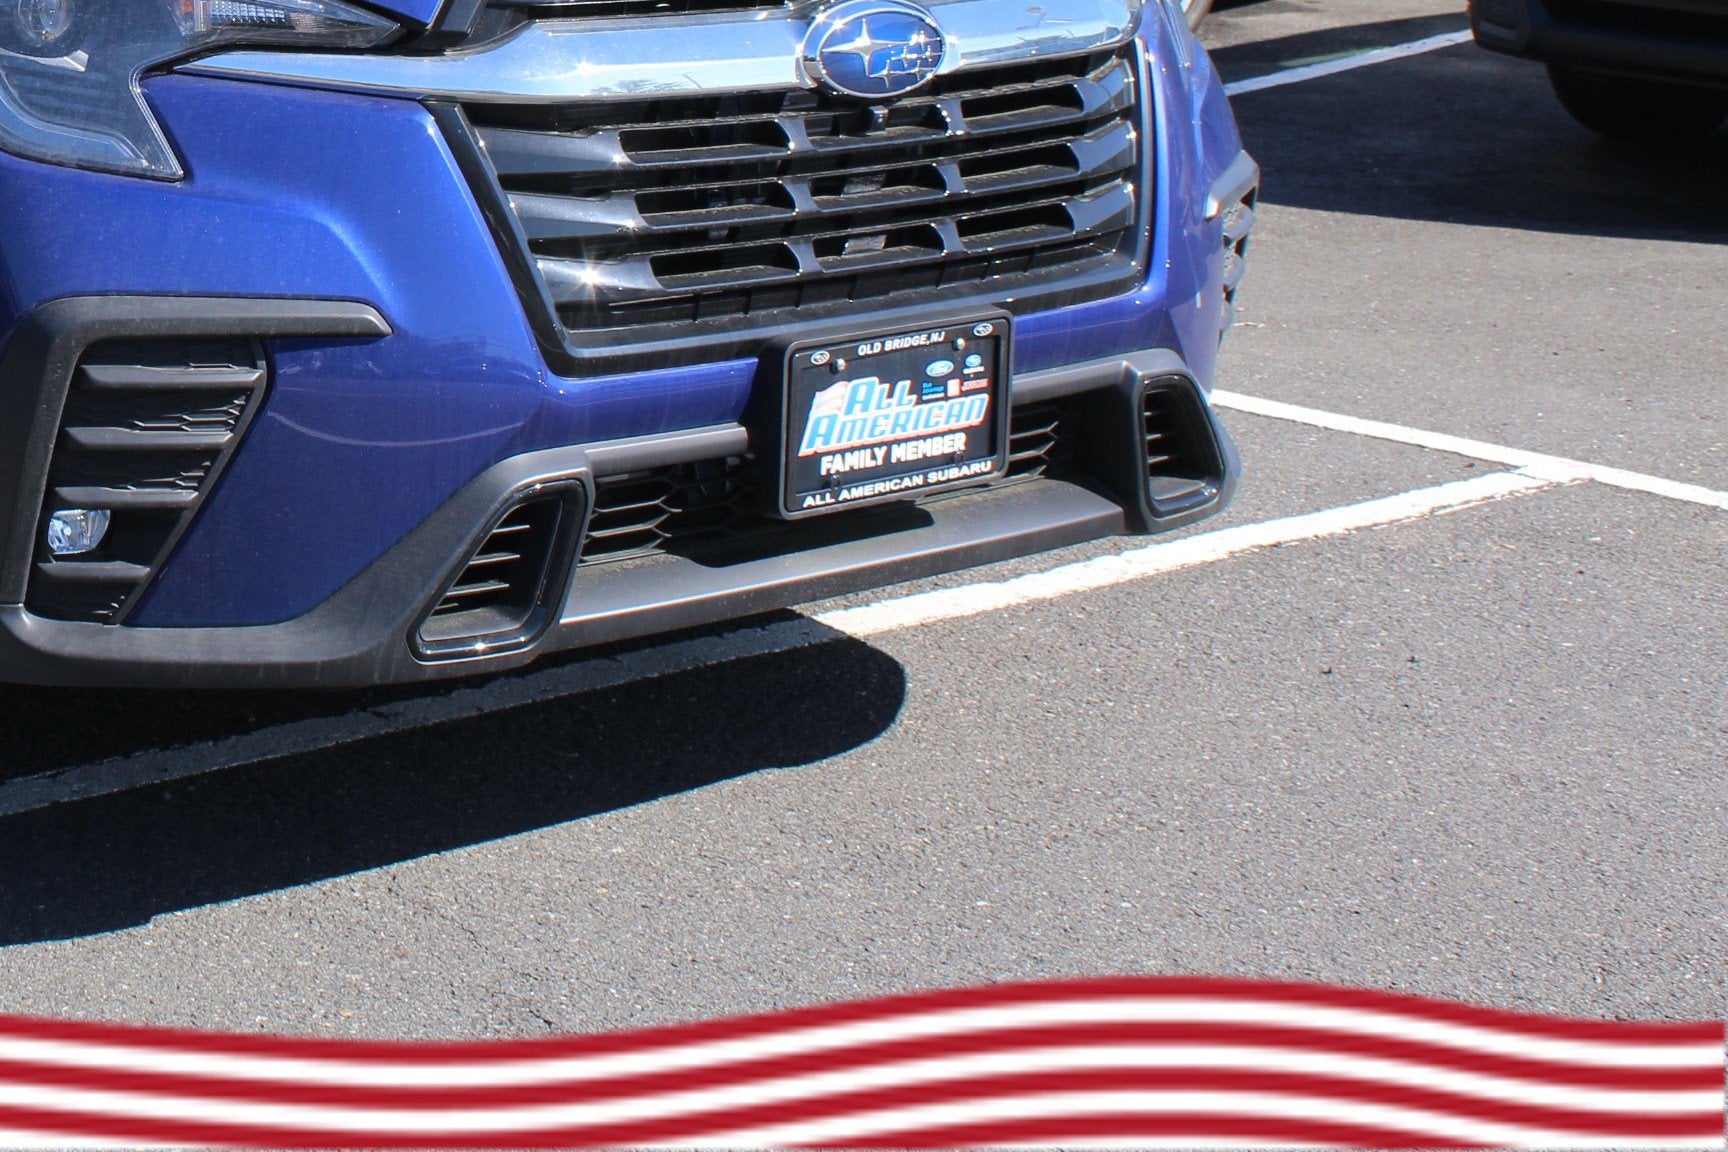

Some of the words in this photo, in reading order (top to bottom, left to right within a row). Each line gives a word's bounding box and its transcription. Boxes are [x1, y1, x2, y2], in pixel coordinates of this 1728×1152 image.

[857, 342, 882, 356] OLD
[843, 376, 921, 416] ALL
[798, 394, 989, 456] AMERICAN
[820, 445, 888, 476] FAMILY
[891, 432, 967, 464] MEMBER
[802, 493, 836, 508] ALL
[838, 473, 924, 502] AMERICAN
[927, 460, 993, 485] SUBARU
